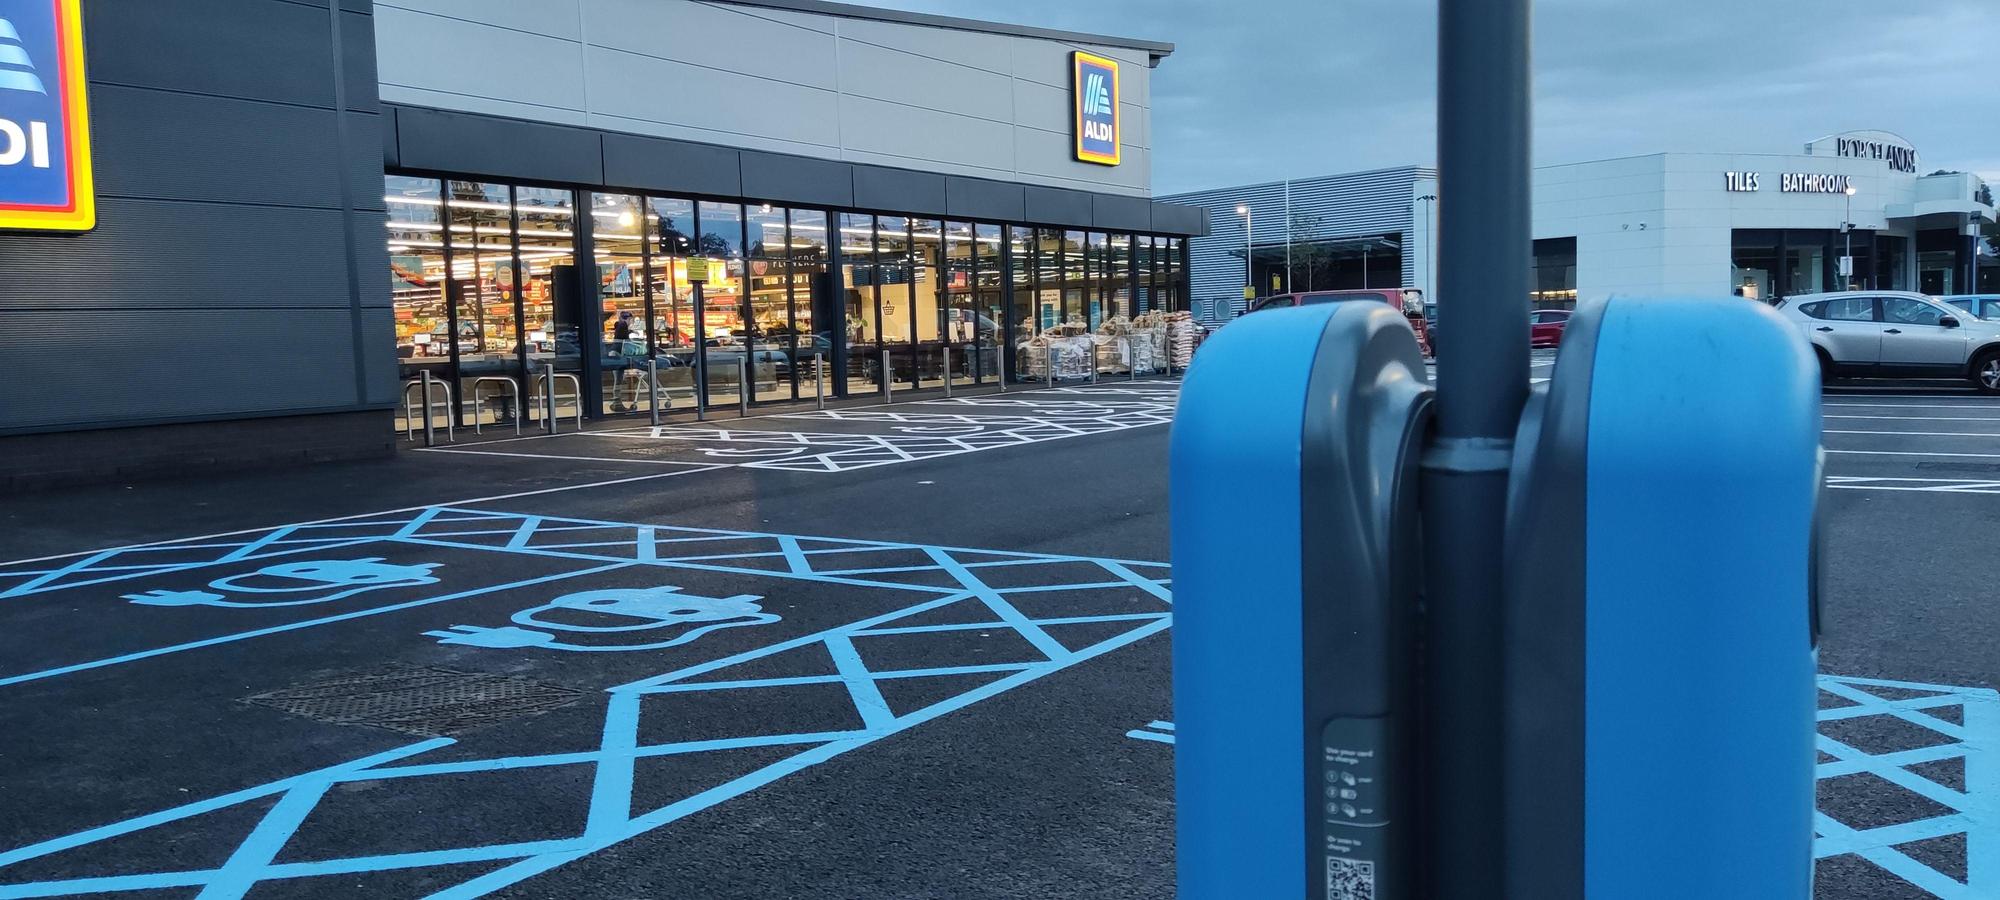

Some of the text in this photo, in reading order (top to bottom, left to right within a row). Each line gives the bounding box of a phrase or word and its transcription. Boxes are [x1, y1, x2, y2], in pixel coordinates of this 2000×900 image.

[1084, 120, 1112, 142] ALDI
[1725, 171, 1852, 194] TILES BATHROOMS
